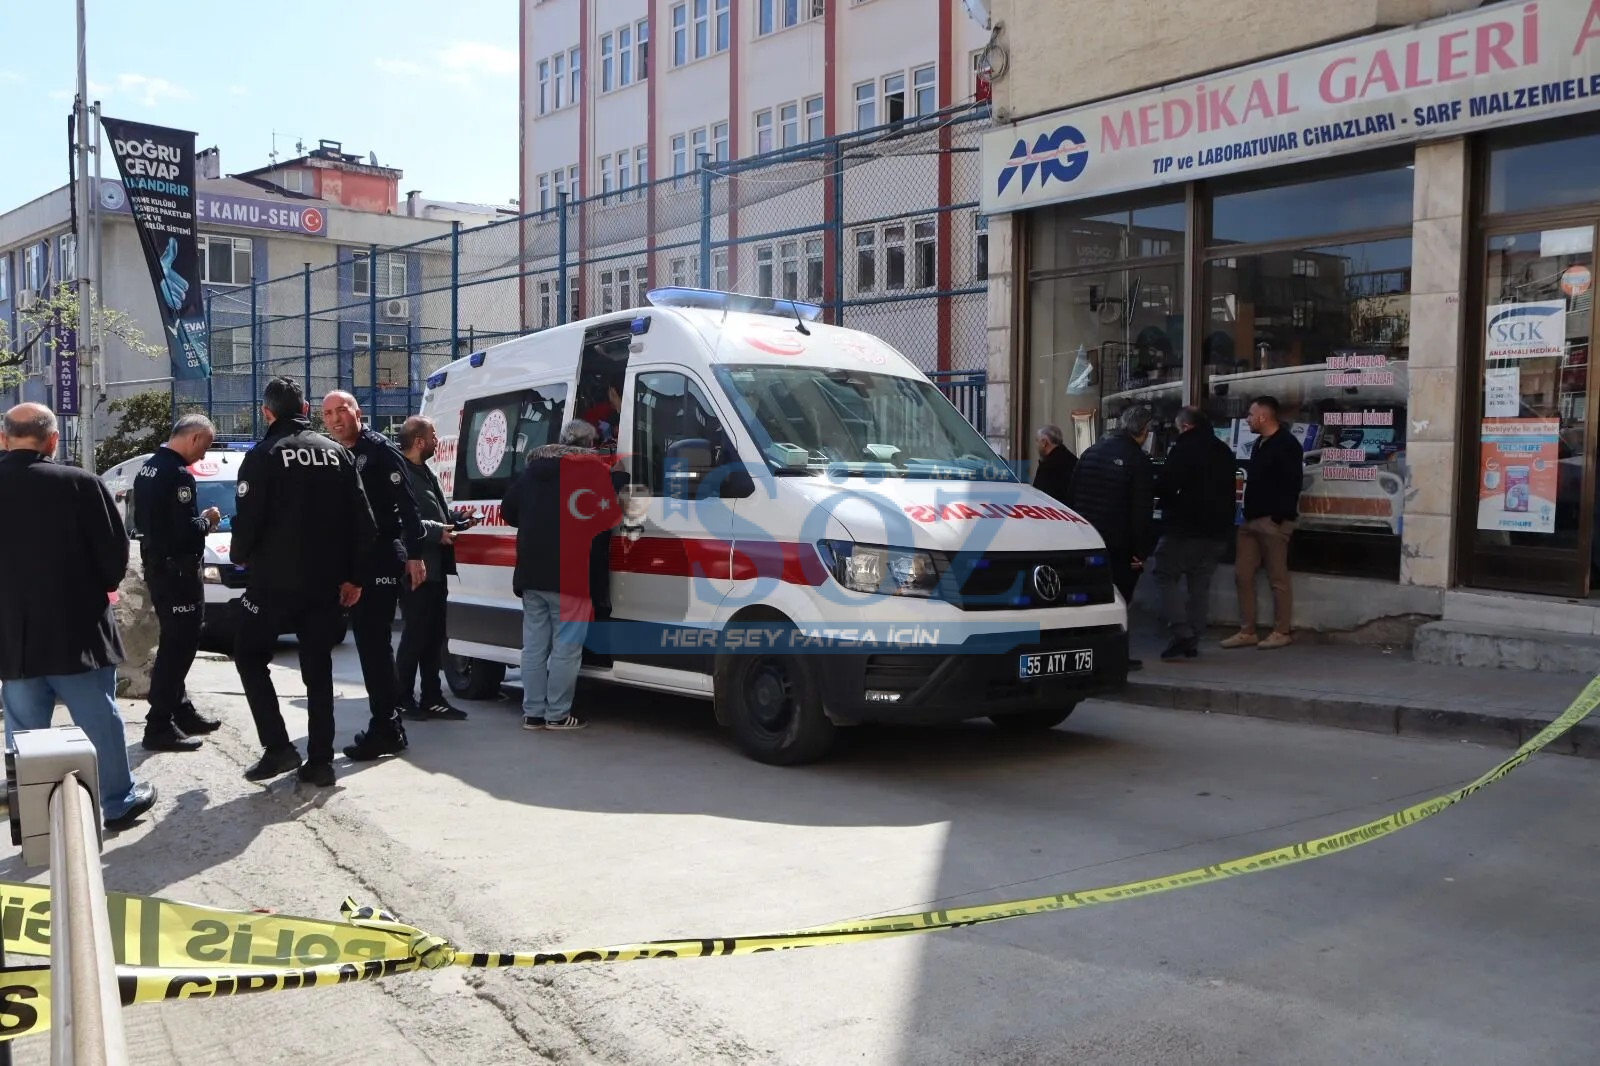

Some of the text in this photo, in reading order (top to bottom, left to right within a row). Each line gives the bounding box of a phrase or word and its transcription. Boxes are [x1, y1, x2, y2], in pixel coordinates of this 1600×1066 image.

[1153, 156, 1173, 174] TIP
[1178, 154, 1194, 170] ve
[1198, 131, 1299, 166] LABORATUVAR
[1413, 101, 1462, 127] SARF
[114, 138, 181, 164] DOĞRU
[125, 158, 180, 180] CEVAP
[210, 201, 299, 228] KAMU-SEN
[1496, 320, 1544, 343] SGK
[1027, 656, 1041, 675] 55
[1047, 653, 1067, 673] ATY
[1074, 651, 1091, 670] 175
